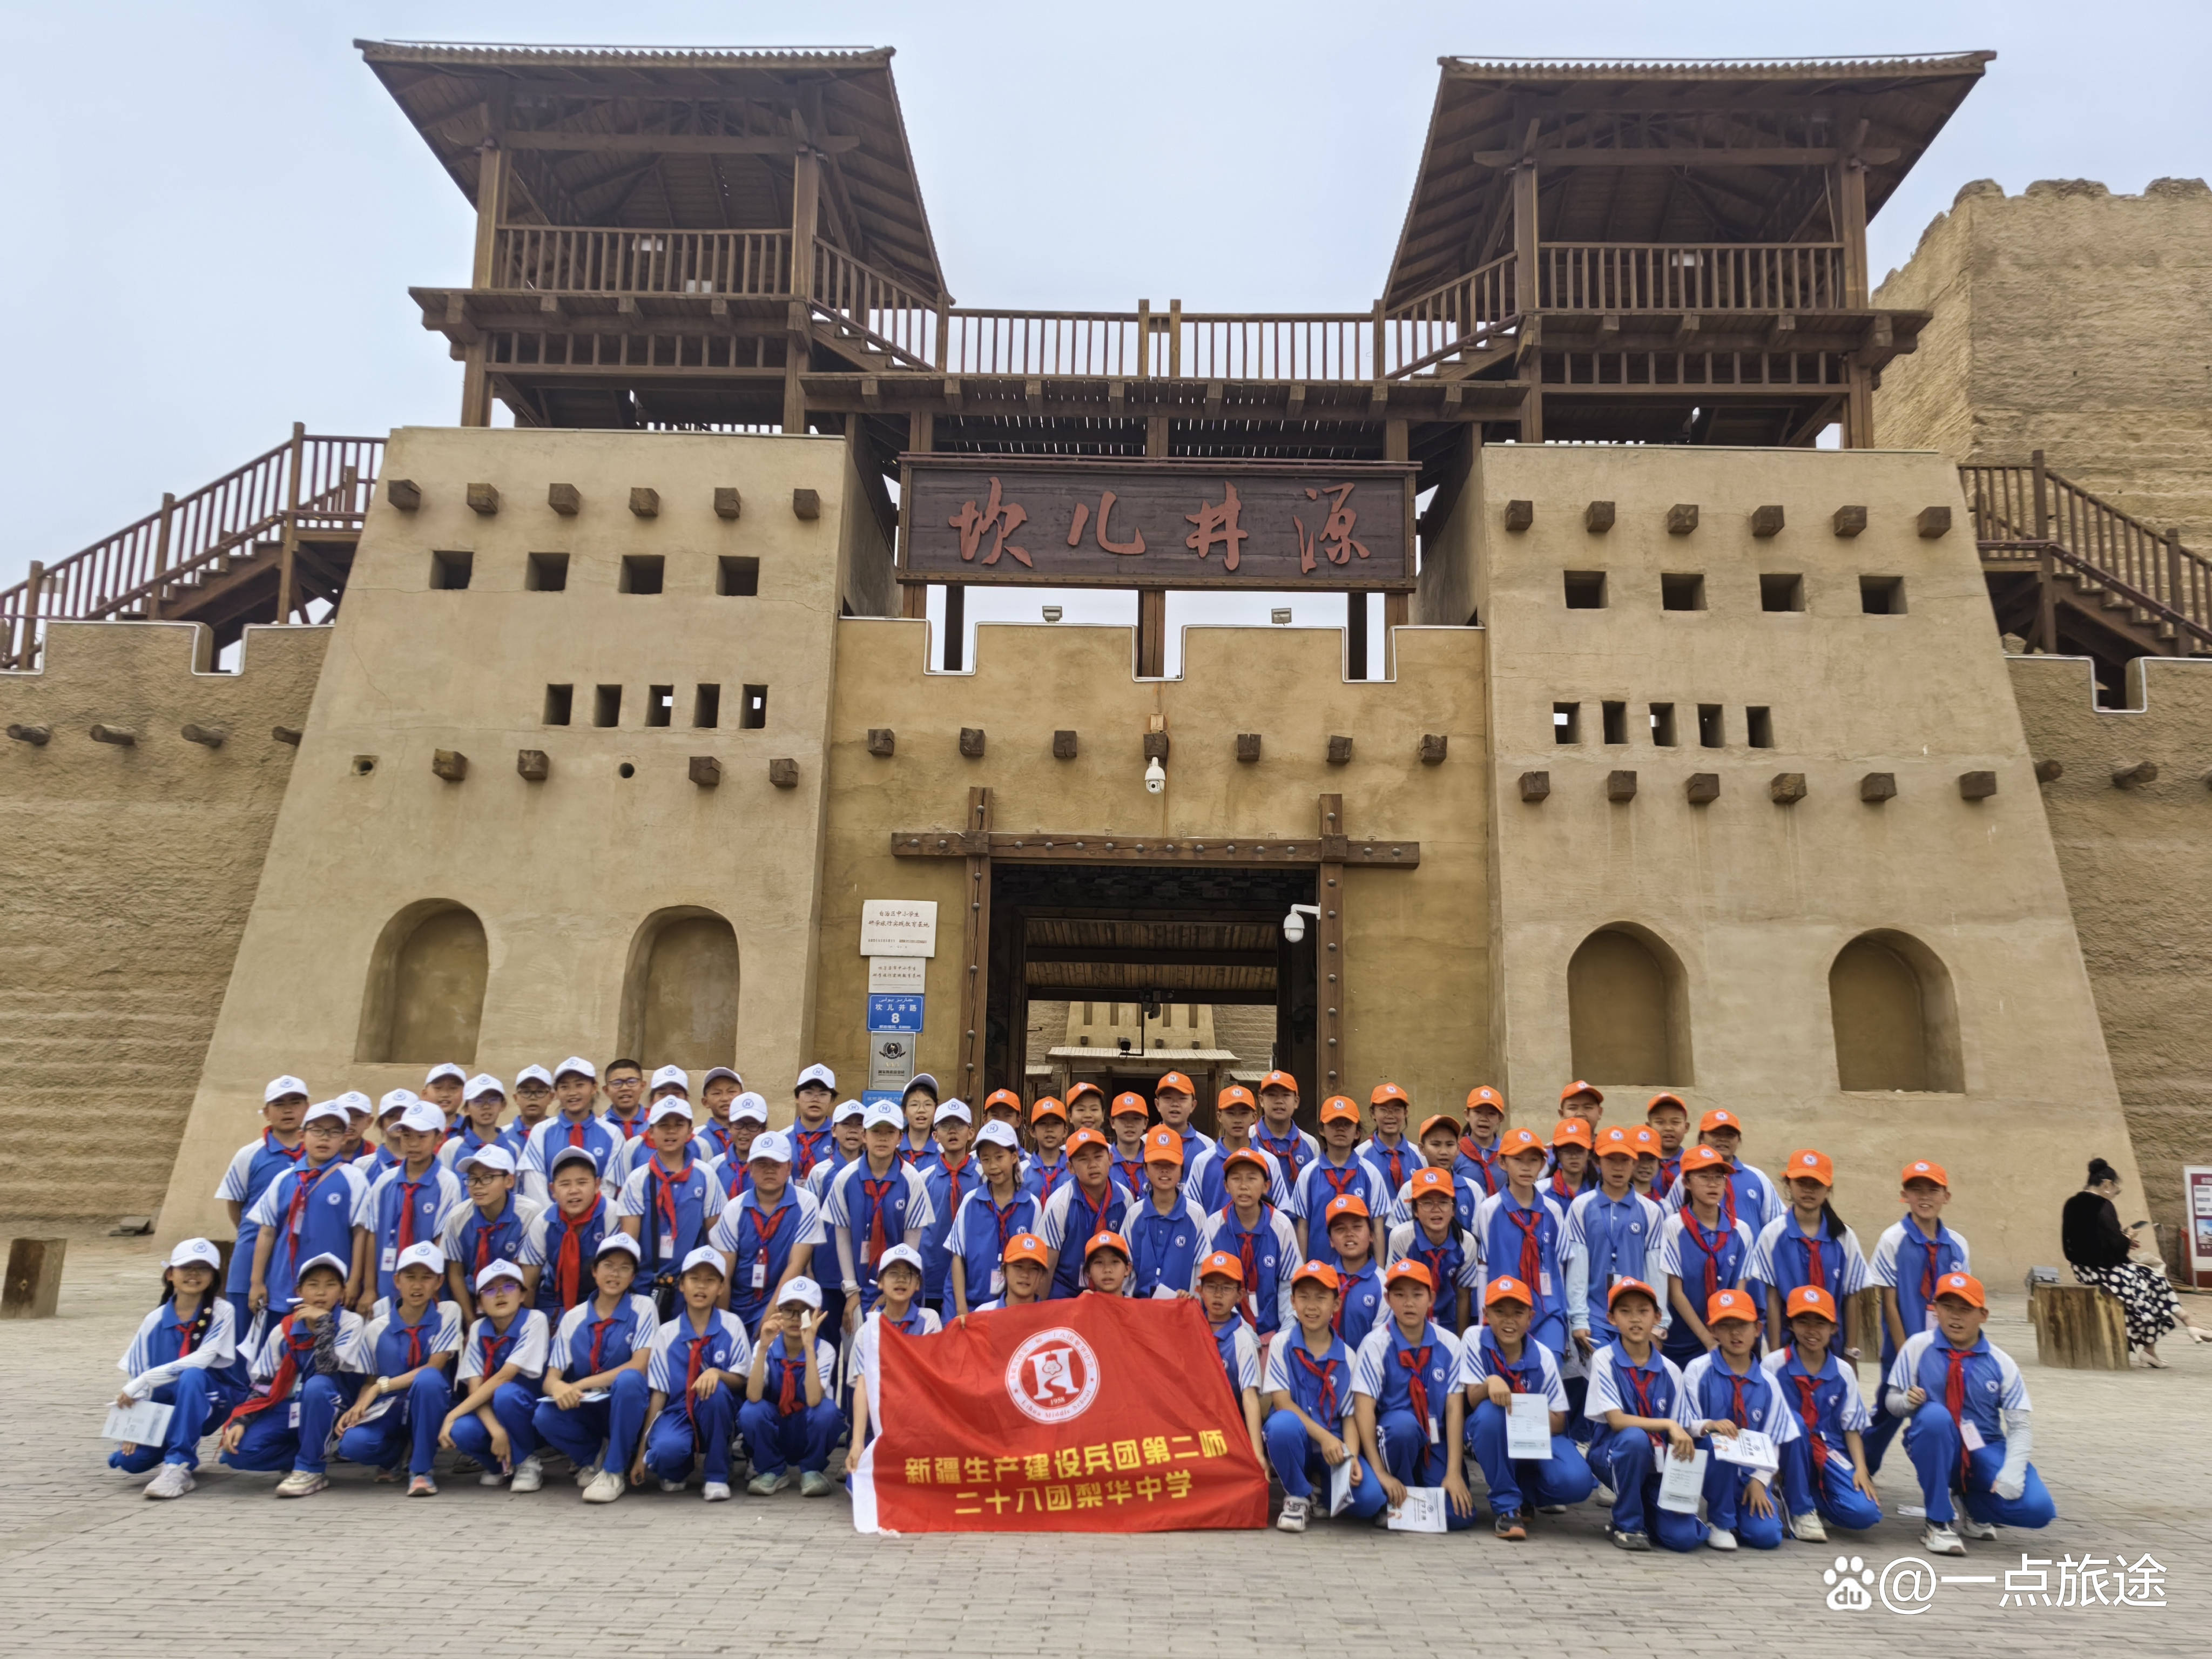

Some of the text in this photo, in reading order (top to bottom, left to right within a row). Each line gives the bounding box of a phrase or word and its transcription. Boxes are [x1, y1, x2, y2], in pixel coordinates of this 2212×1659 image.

[948, 476, 1370, 575] 坎儿井源
[875, 1003, 917, 1011] 坎儿井路
[891, 1013, 900, 1024] 8
[1045, 1410, 1070, 1418] Middle
[905, 1429, 1228, 1485] 新疆生产建设兵团第二师
[955, 1469, 1192, 1515] 二十八团梨华中学
